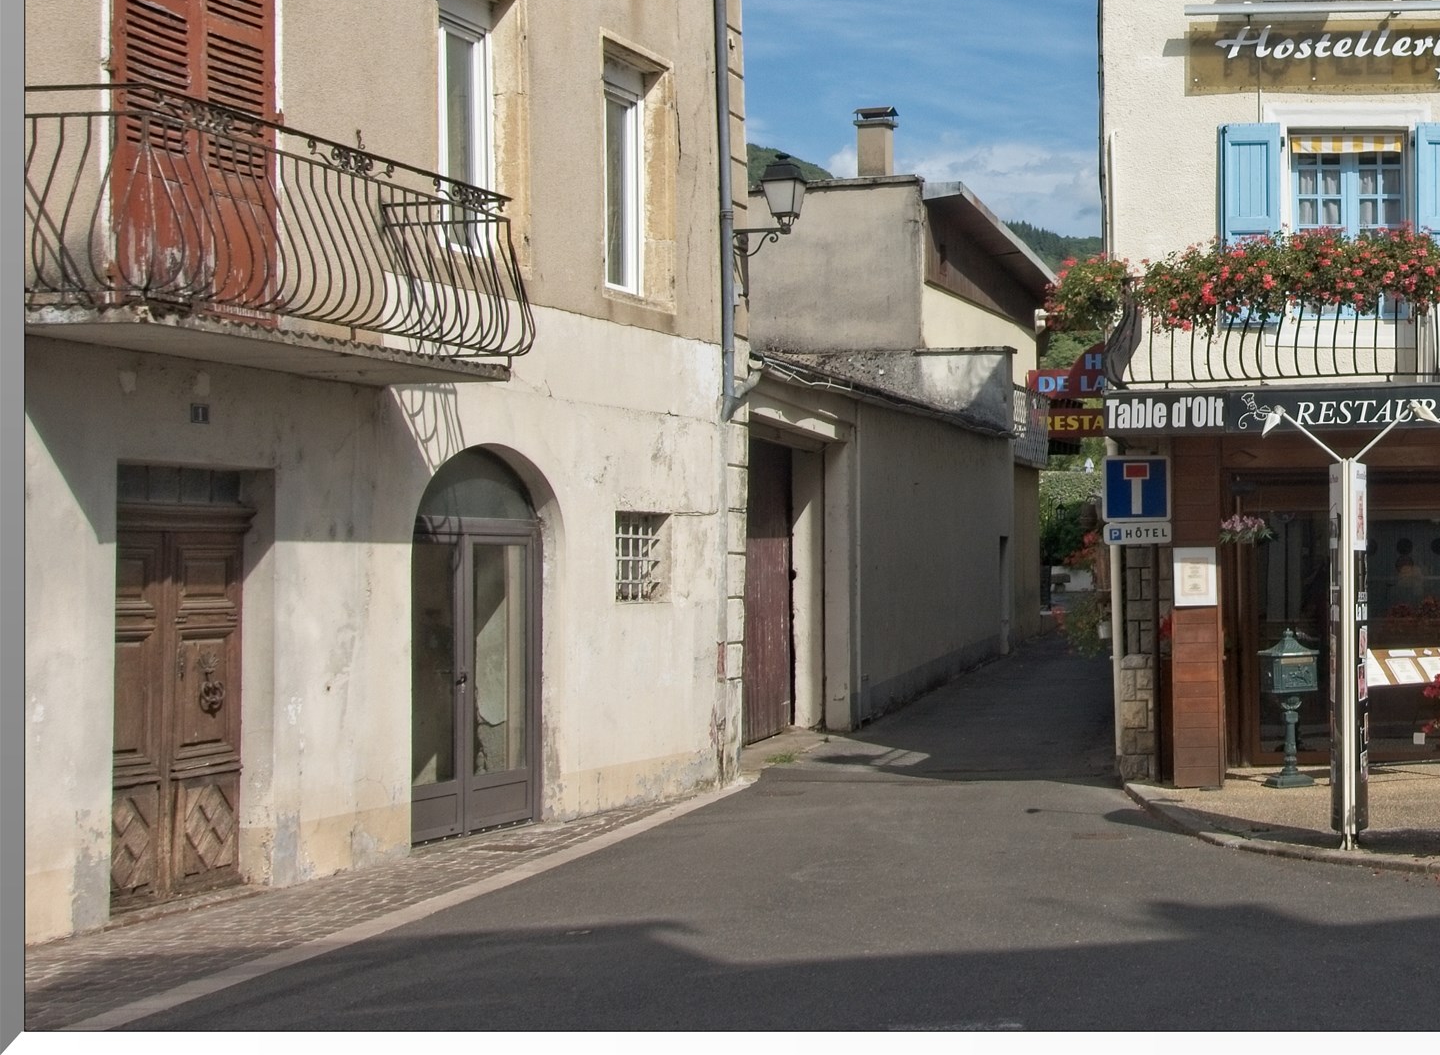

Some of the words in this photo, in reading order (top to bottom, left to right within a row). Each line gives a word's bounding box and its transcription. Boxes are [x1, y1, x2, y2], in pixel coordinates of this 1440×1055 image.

[1037, 375, 1069, 393] DE
[1105, 397, 1167, 429] Table
[1171, 395, 1225, 428] d'Olt
[1125, 526, 1168, 539] HÔTEL
